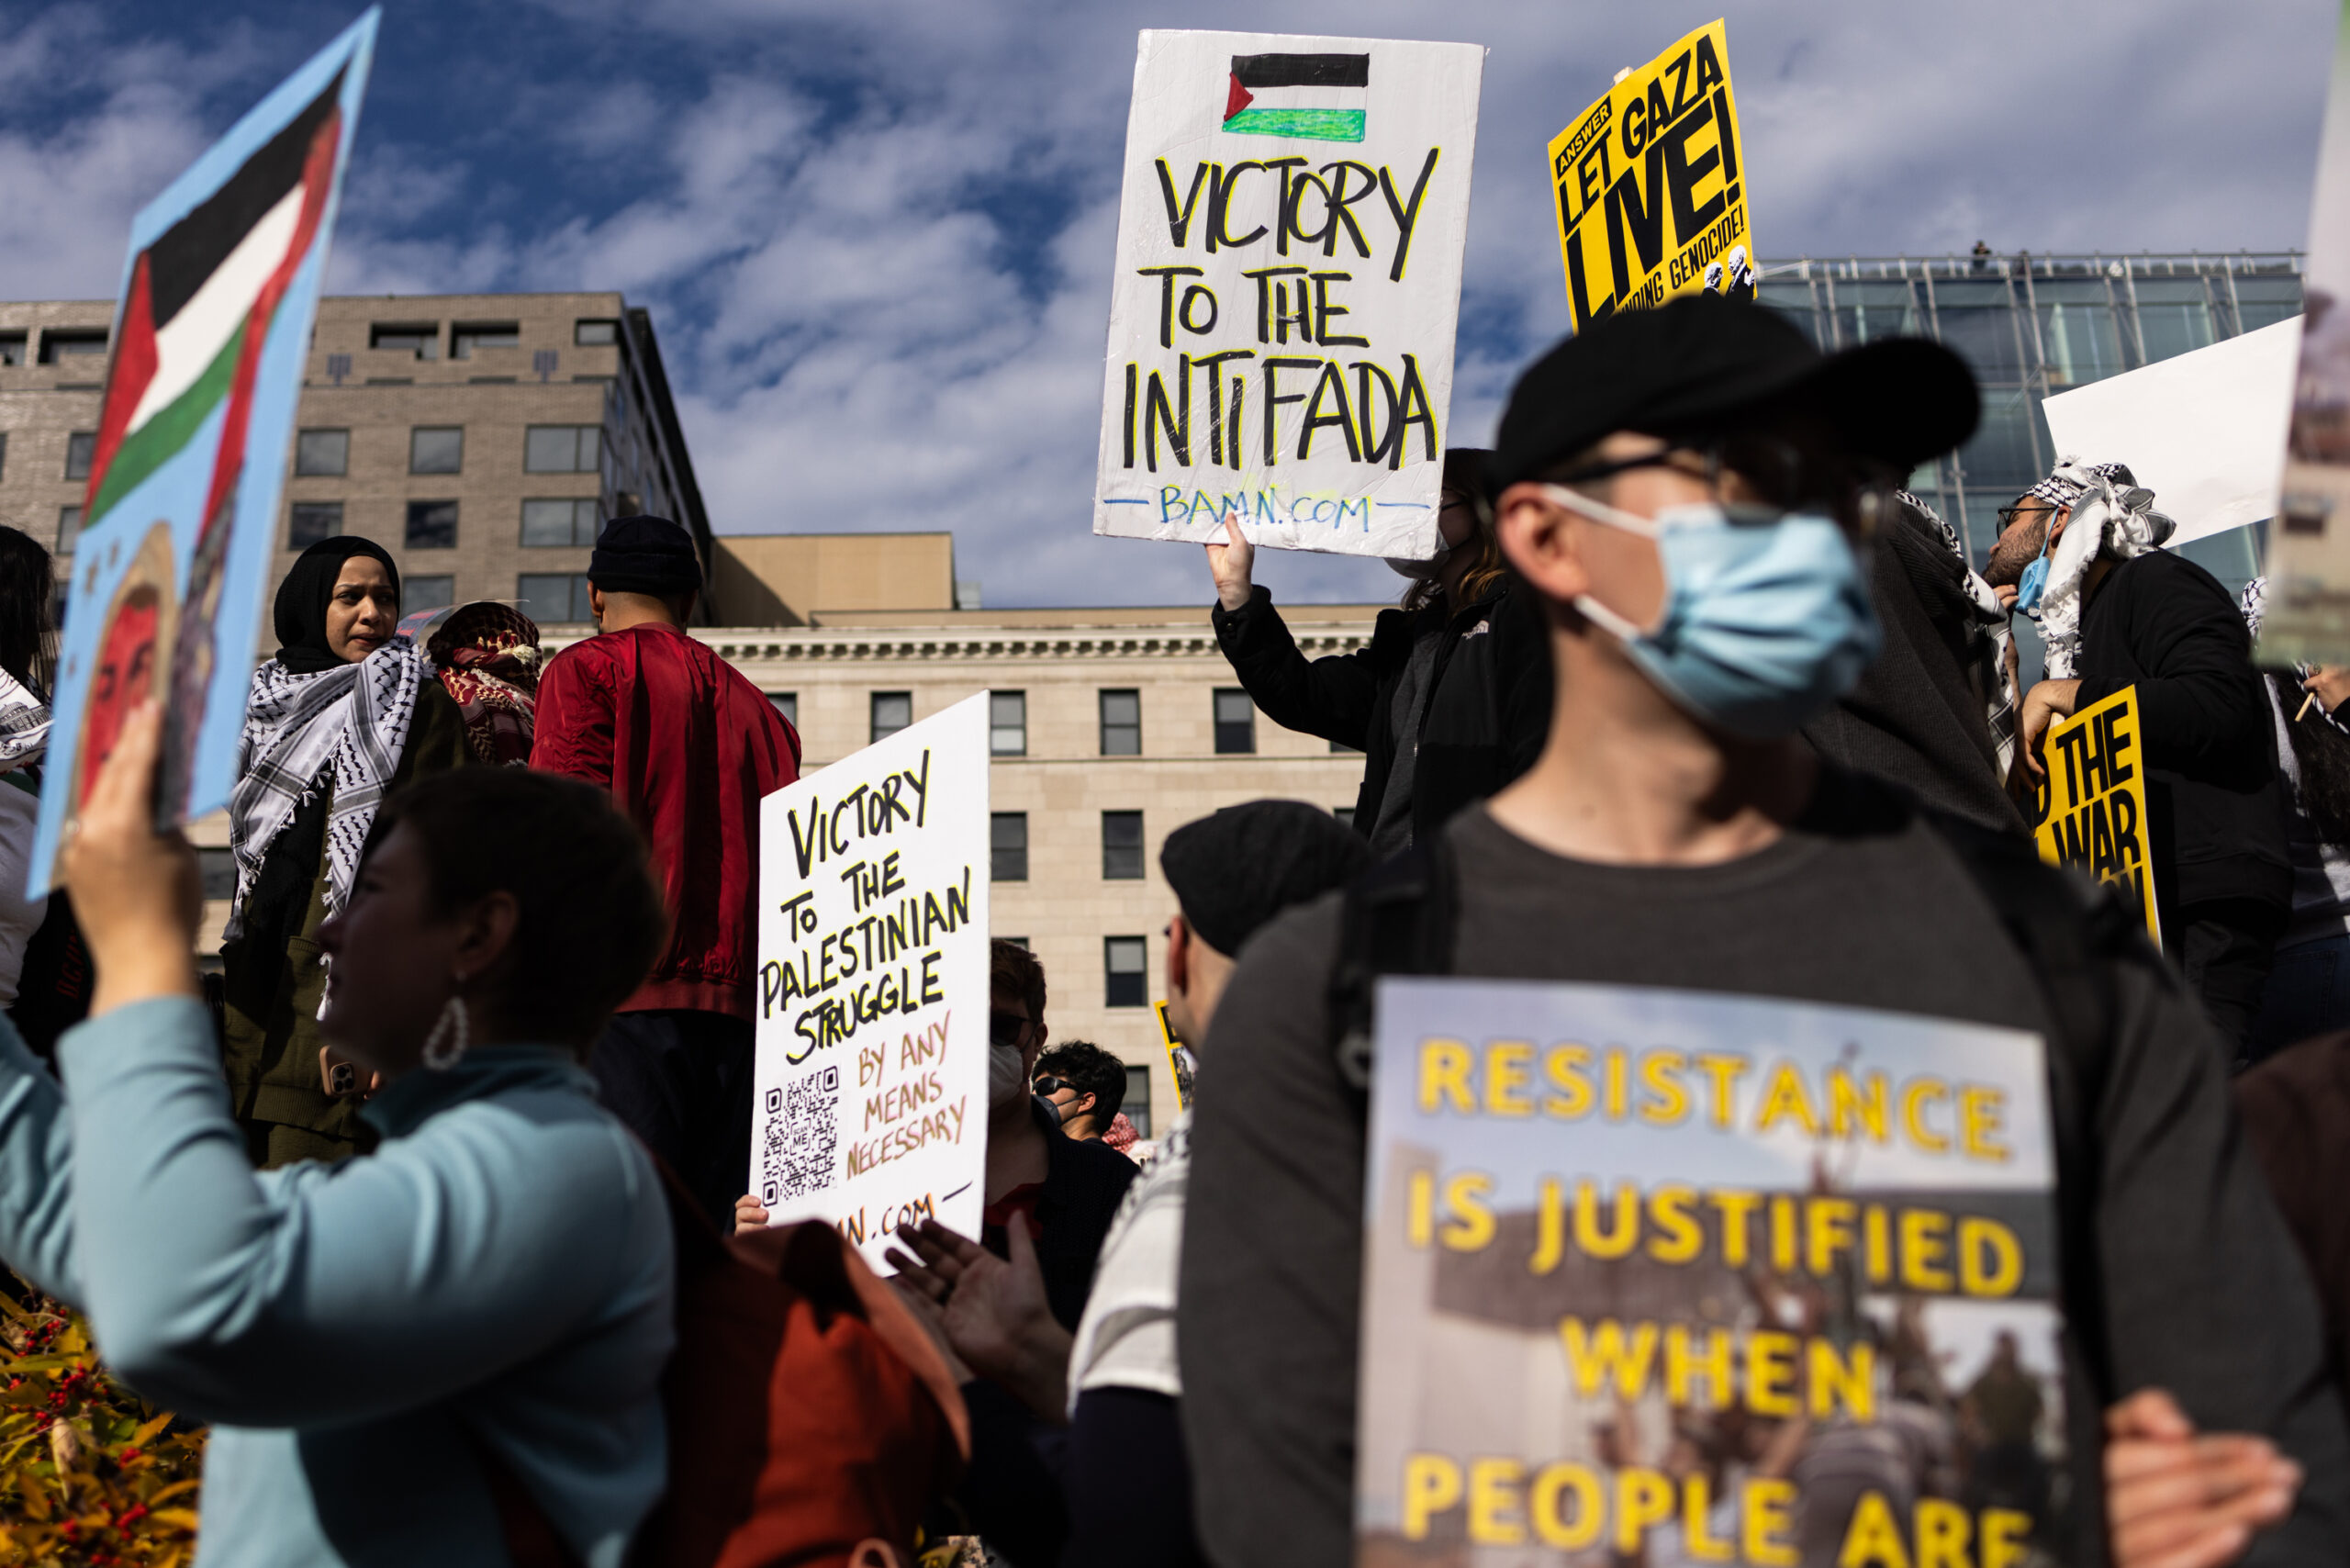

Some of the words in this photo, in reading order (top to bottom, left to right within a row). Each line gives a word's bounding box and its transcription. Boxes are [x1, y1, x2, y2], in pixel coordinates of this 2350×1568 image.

[1558, 101, 1609, 173] ANSWER
[1559, 125, 1613, 238] LET
[1621, 33, 1724, 160] GAZA
[1154, 146, 1441, 283] VICTORY
[1566, 85, 1741, 334] LIVE!
[1669, 204, 1745, 291] GENOCIDE!
[1136, 264, 1219, 350] TO
[1240, 265, 1371, 349] THE
[1123, 349, 1438, 474] INTIFADA
[1158, 484, 1371, 533] BAMN.COM
[2055, 700, 2133, 810] THE
[788, 745, 931, 880] VICTORY
[2051, 788, 2142, 881] WAR
[758, 865, 971, 1020] PALESTINIAN
[779, 889, 819, 944] TO
[840, 849, 907, 914] THE
[785, 950, 945, 1066] STRUGGLE
[857, 1040, 887, 1088] BY
[900, 1008, 952, 1071] ANY
[792, 1133, 808, 1148] ME
[846, 1093, 968, 1182] NECESSARY
[864, 1070, 945, 1133] MEANS
[1416, 1037, 2014, 1164] RESISTANCE
[836, 1192, 935, 1247] N.COM
[1407, 1169, 1500, 1252] IS
[1528, 1176, 2025, 1299] JUSTIFIED
[1561, 1315, 1878, 1425] WHEN
[1401, 1451, 1803, 1568] PEOPLE
